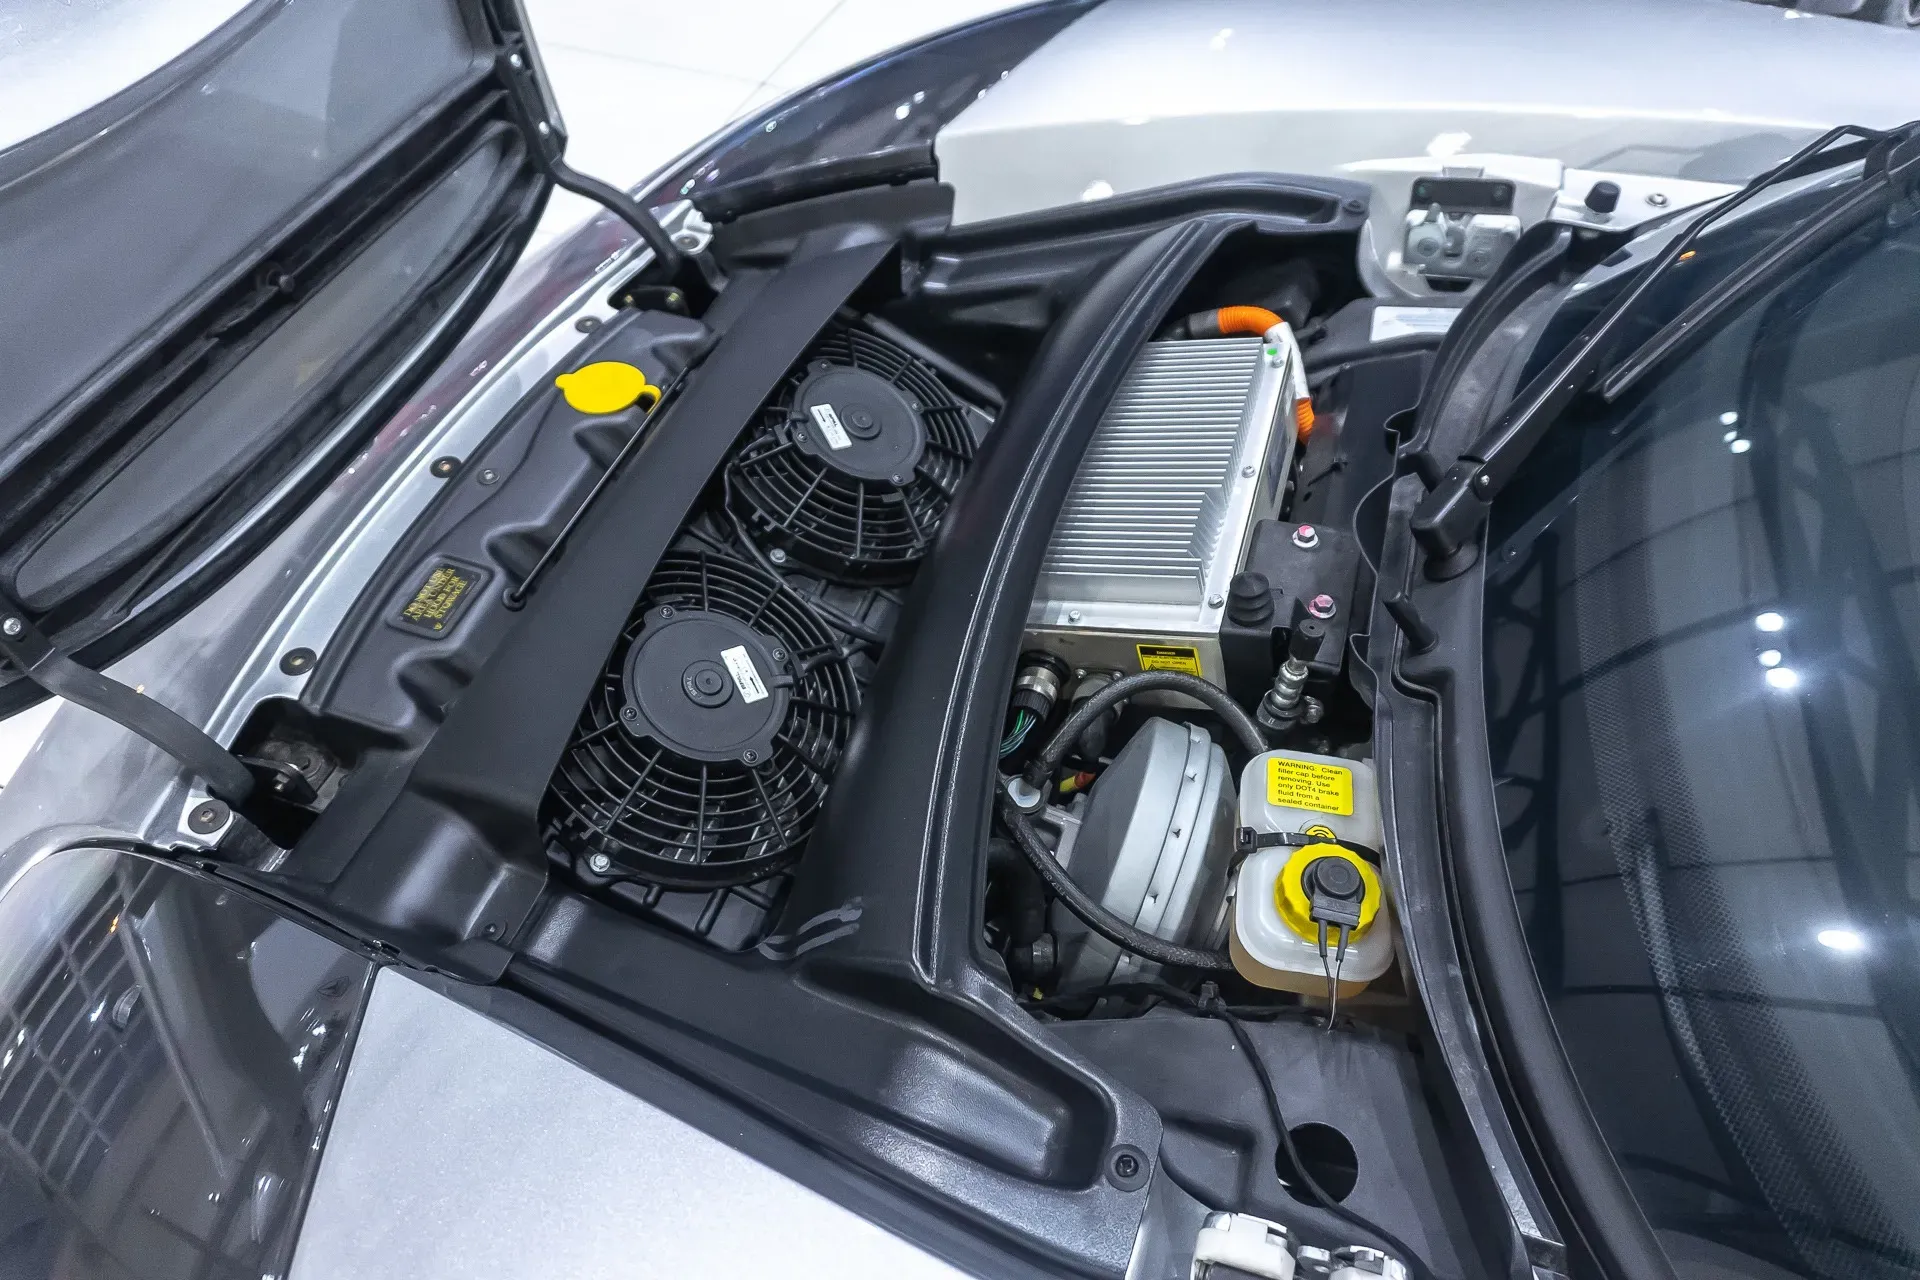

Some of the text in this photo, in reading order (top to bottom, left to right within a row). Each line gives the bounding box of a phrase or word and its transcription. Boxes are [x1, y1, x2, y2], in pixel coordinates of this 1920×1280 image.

[423, 592, 448, 618] HOOD
[443, 575, 461, 592] FOR
[434, 580, 468, 619] STOWAGE
[1278, 761, 1343, 776] WARNING: Clean
[1278, 776, 1314, 786] removing.
[1311, 773, 1336, 782] before
[1278, 783, 1340, 797] only DOT4 brake
[1296, 792, 1313, 800] from
[1278, 797, 1339, 811] sealed container
